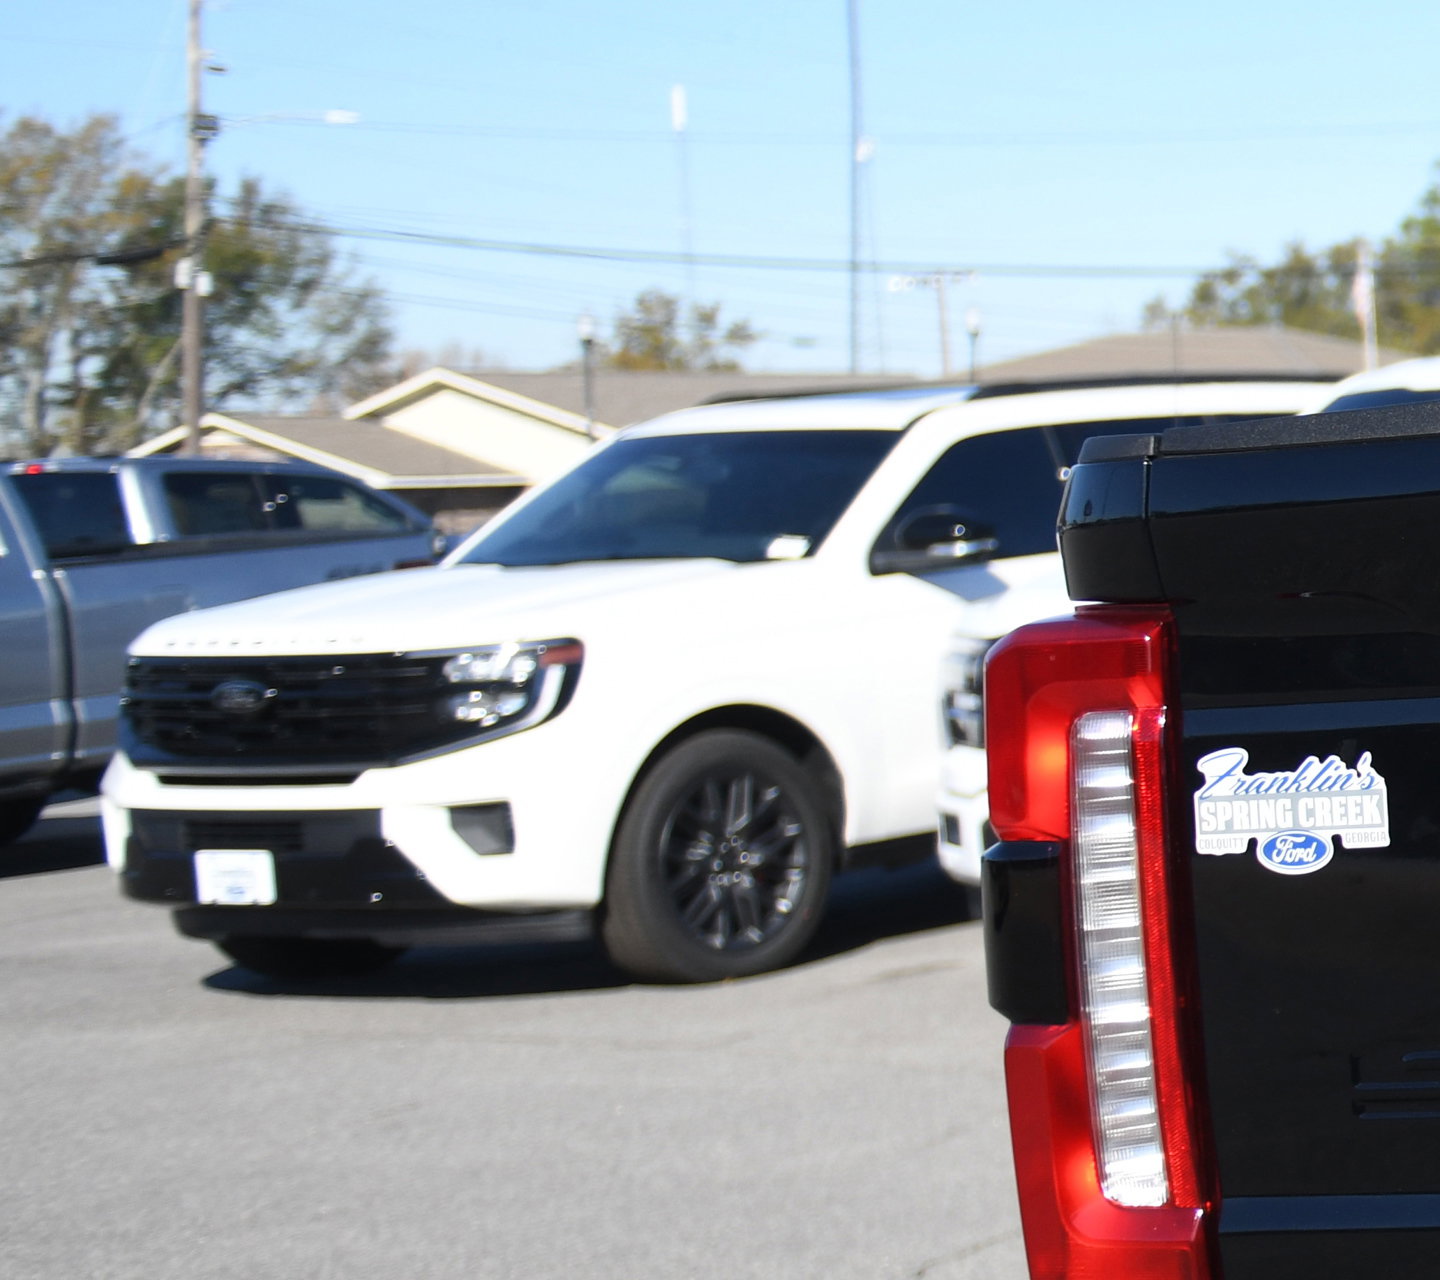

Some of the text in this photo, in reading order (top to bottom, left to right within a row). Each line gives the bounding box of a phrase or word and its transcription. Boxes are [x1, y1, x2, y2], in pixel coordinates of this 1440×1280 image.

[1199, 751, 1381, 800] Franklin's
[1200, 794, 1382, 832] SPRING CREEK
[1199, 837, 1245, 850] COLQUITT
[1271, 835, 1318, 863] Ford
[1345, 831, 1387, 844] GEORGIA
